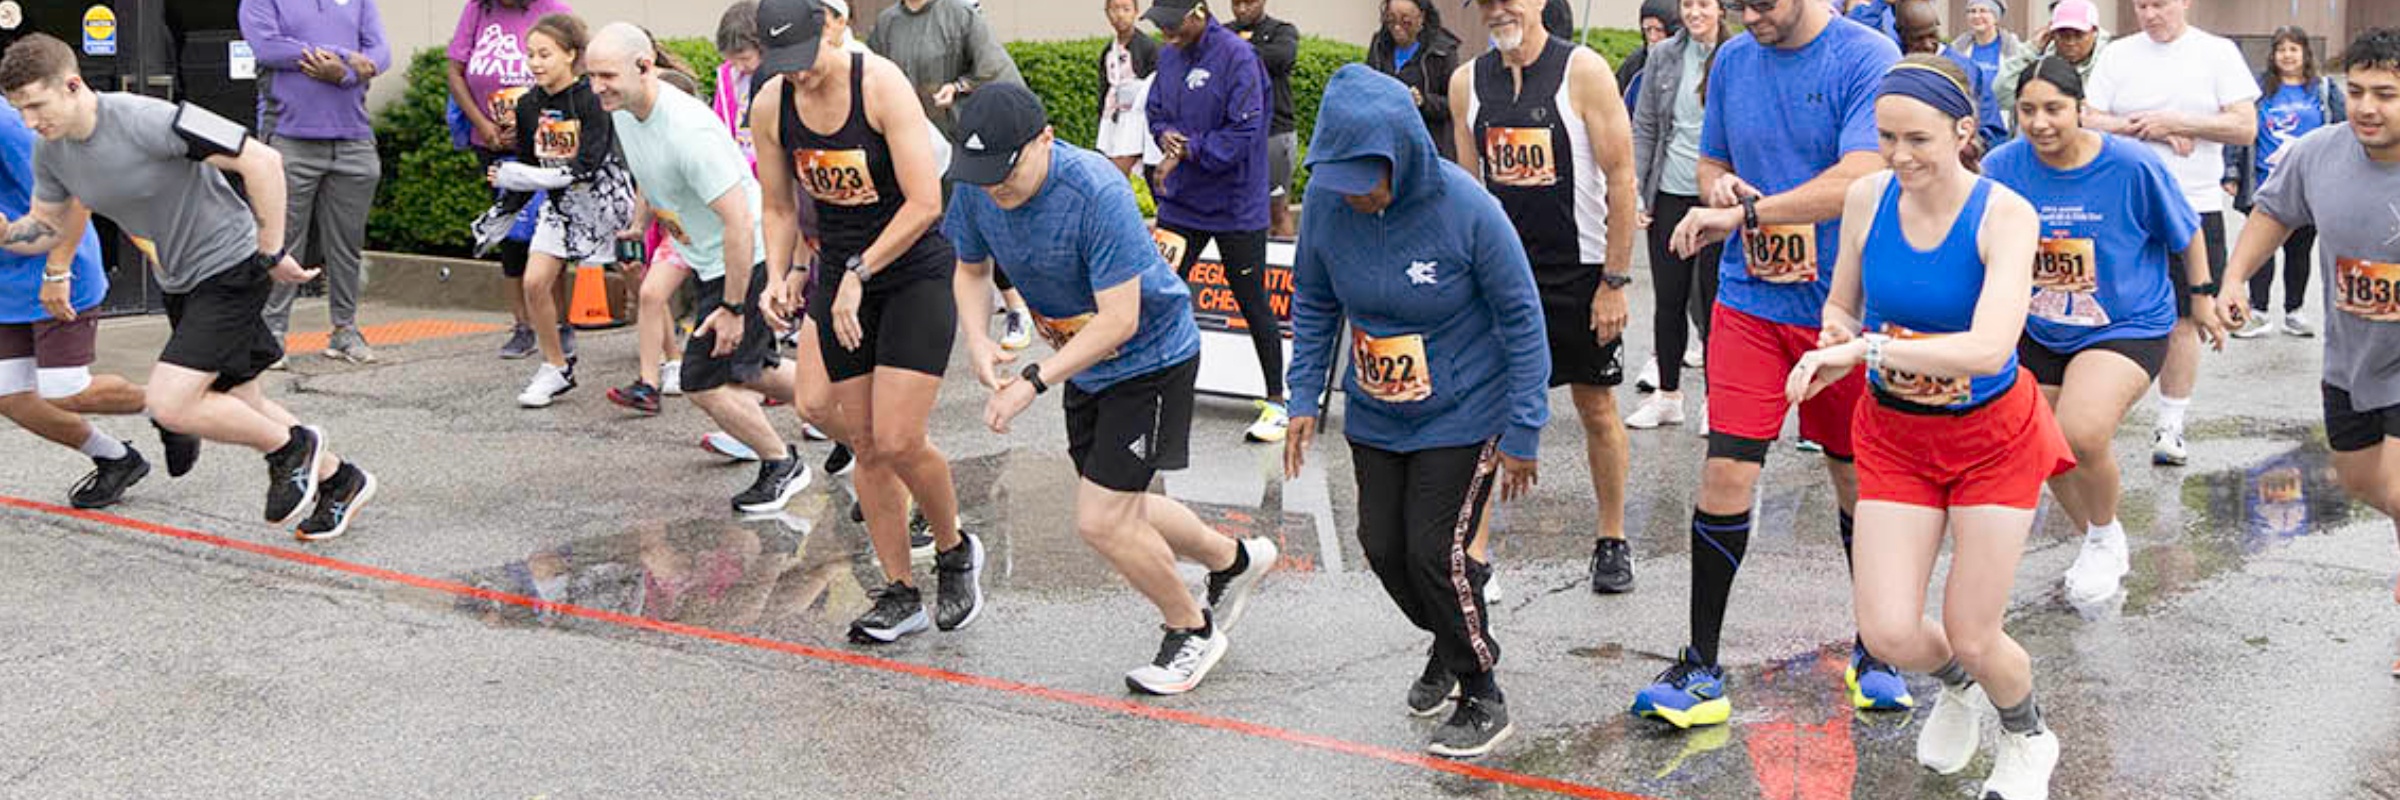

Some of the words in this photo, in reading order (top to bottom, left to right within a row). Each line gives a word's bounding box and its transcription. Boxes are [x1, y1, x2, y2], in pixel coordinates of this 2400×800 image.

[1494, 144, 1544, 174] 1840
[805, 166, 863, 193] 1823
[1746, 232, 1805, 266] 1820
[2033, 251, 2085, 278] 1851
[1359, 350, 1416, 382] 1822
